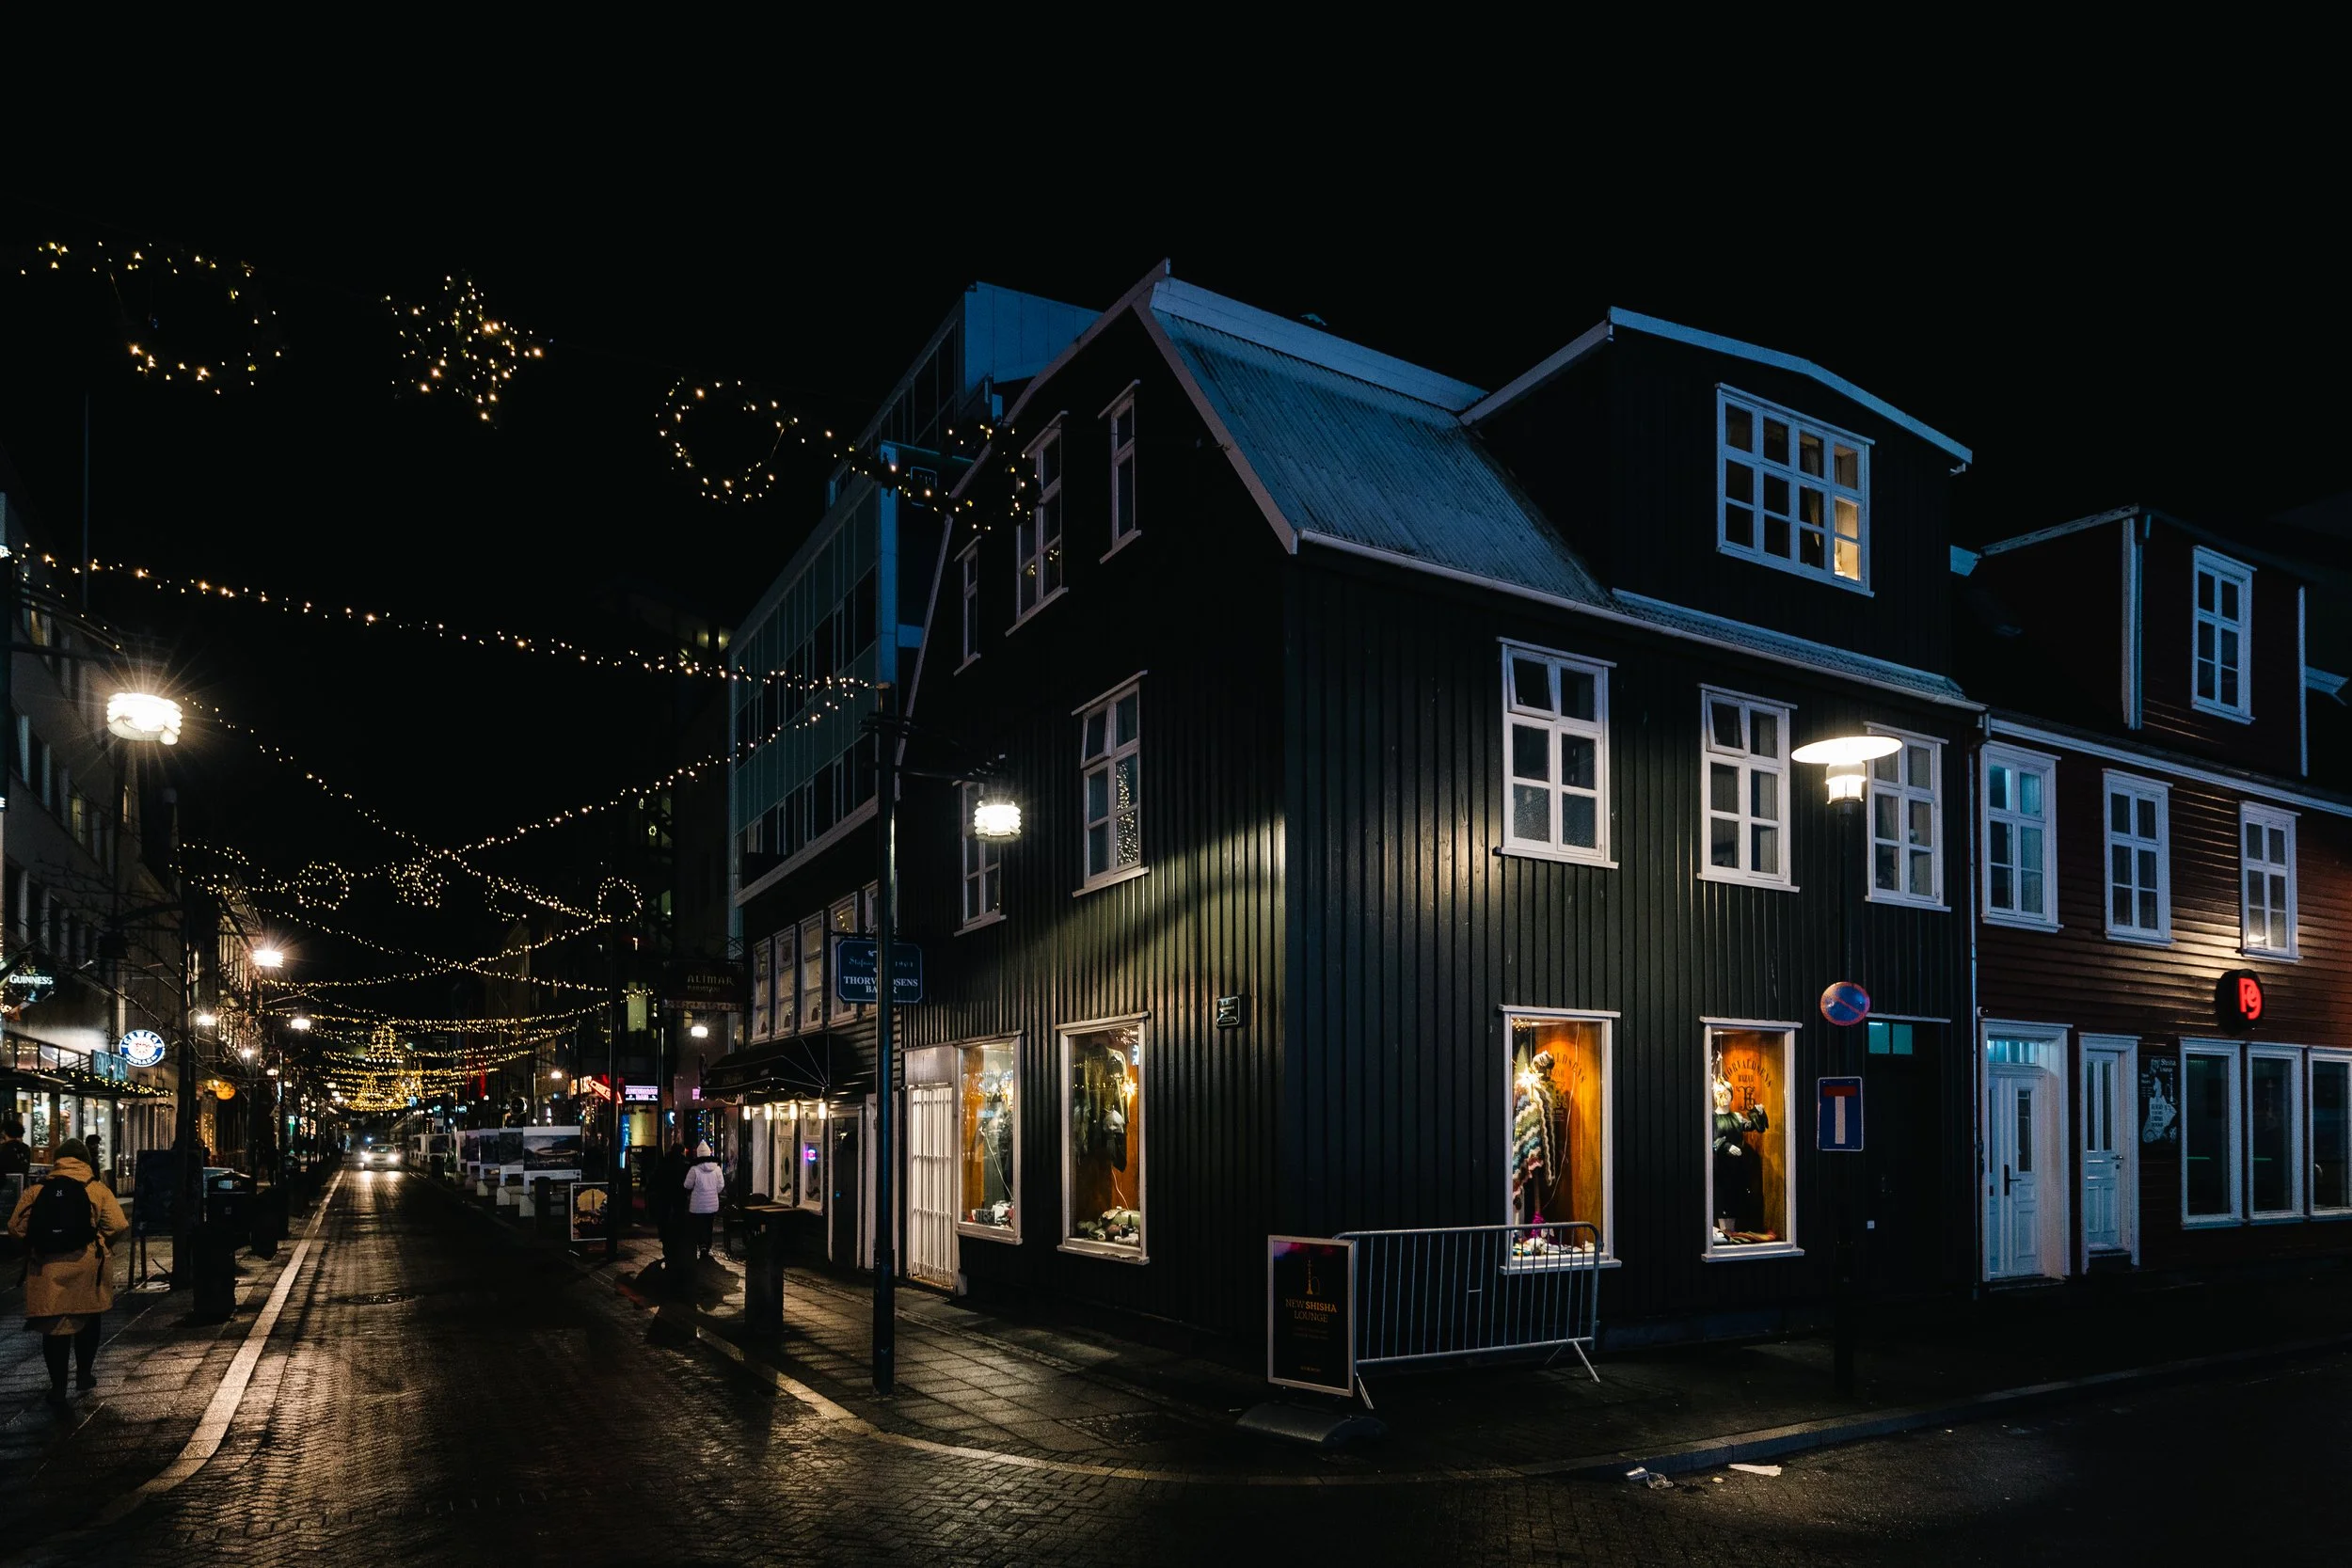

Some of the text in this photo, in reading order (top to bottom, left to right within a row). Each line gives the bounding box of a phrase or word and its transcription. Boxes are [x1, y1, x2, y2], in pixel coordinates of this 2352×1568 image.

[9, 974, 54, 985] GUINNESS
[843, 975, 919, 987] THORVSENS
[866, 985, 898, 994] BAR
[1285, 1298, 1338, 1313] NEW SHISHA
[1294, 1310, 1329, 1323] LOUNGE
